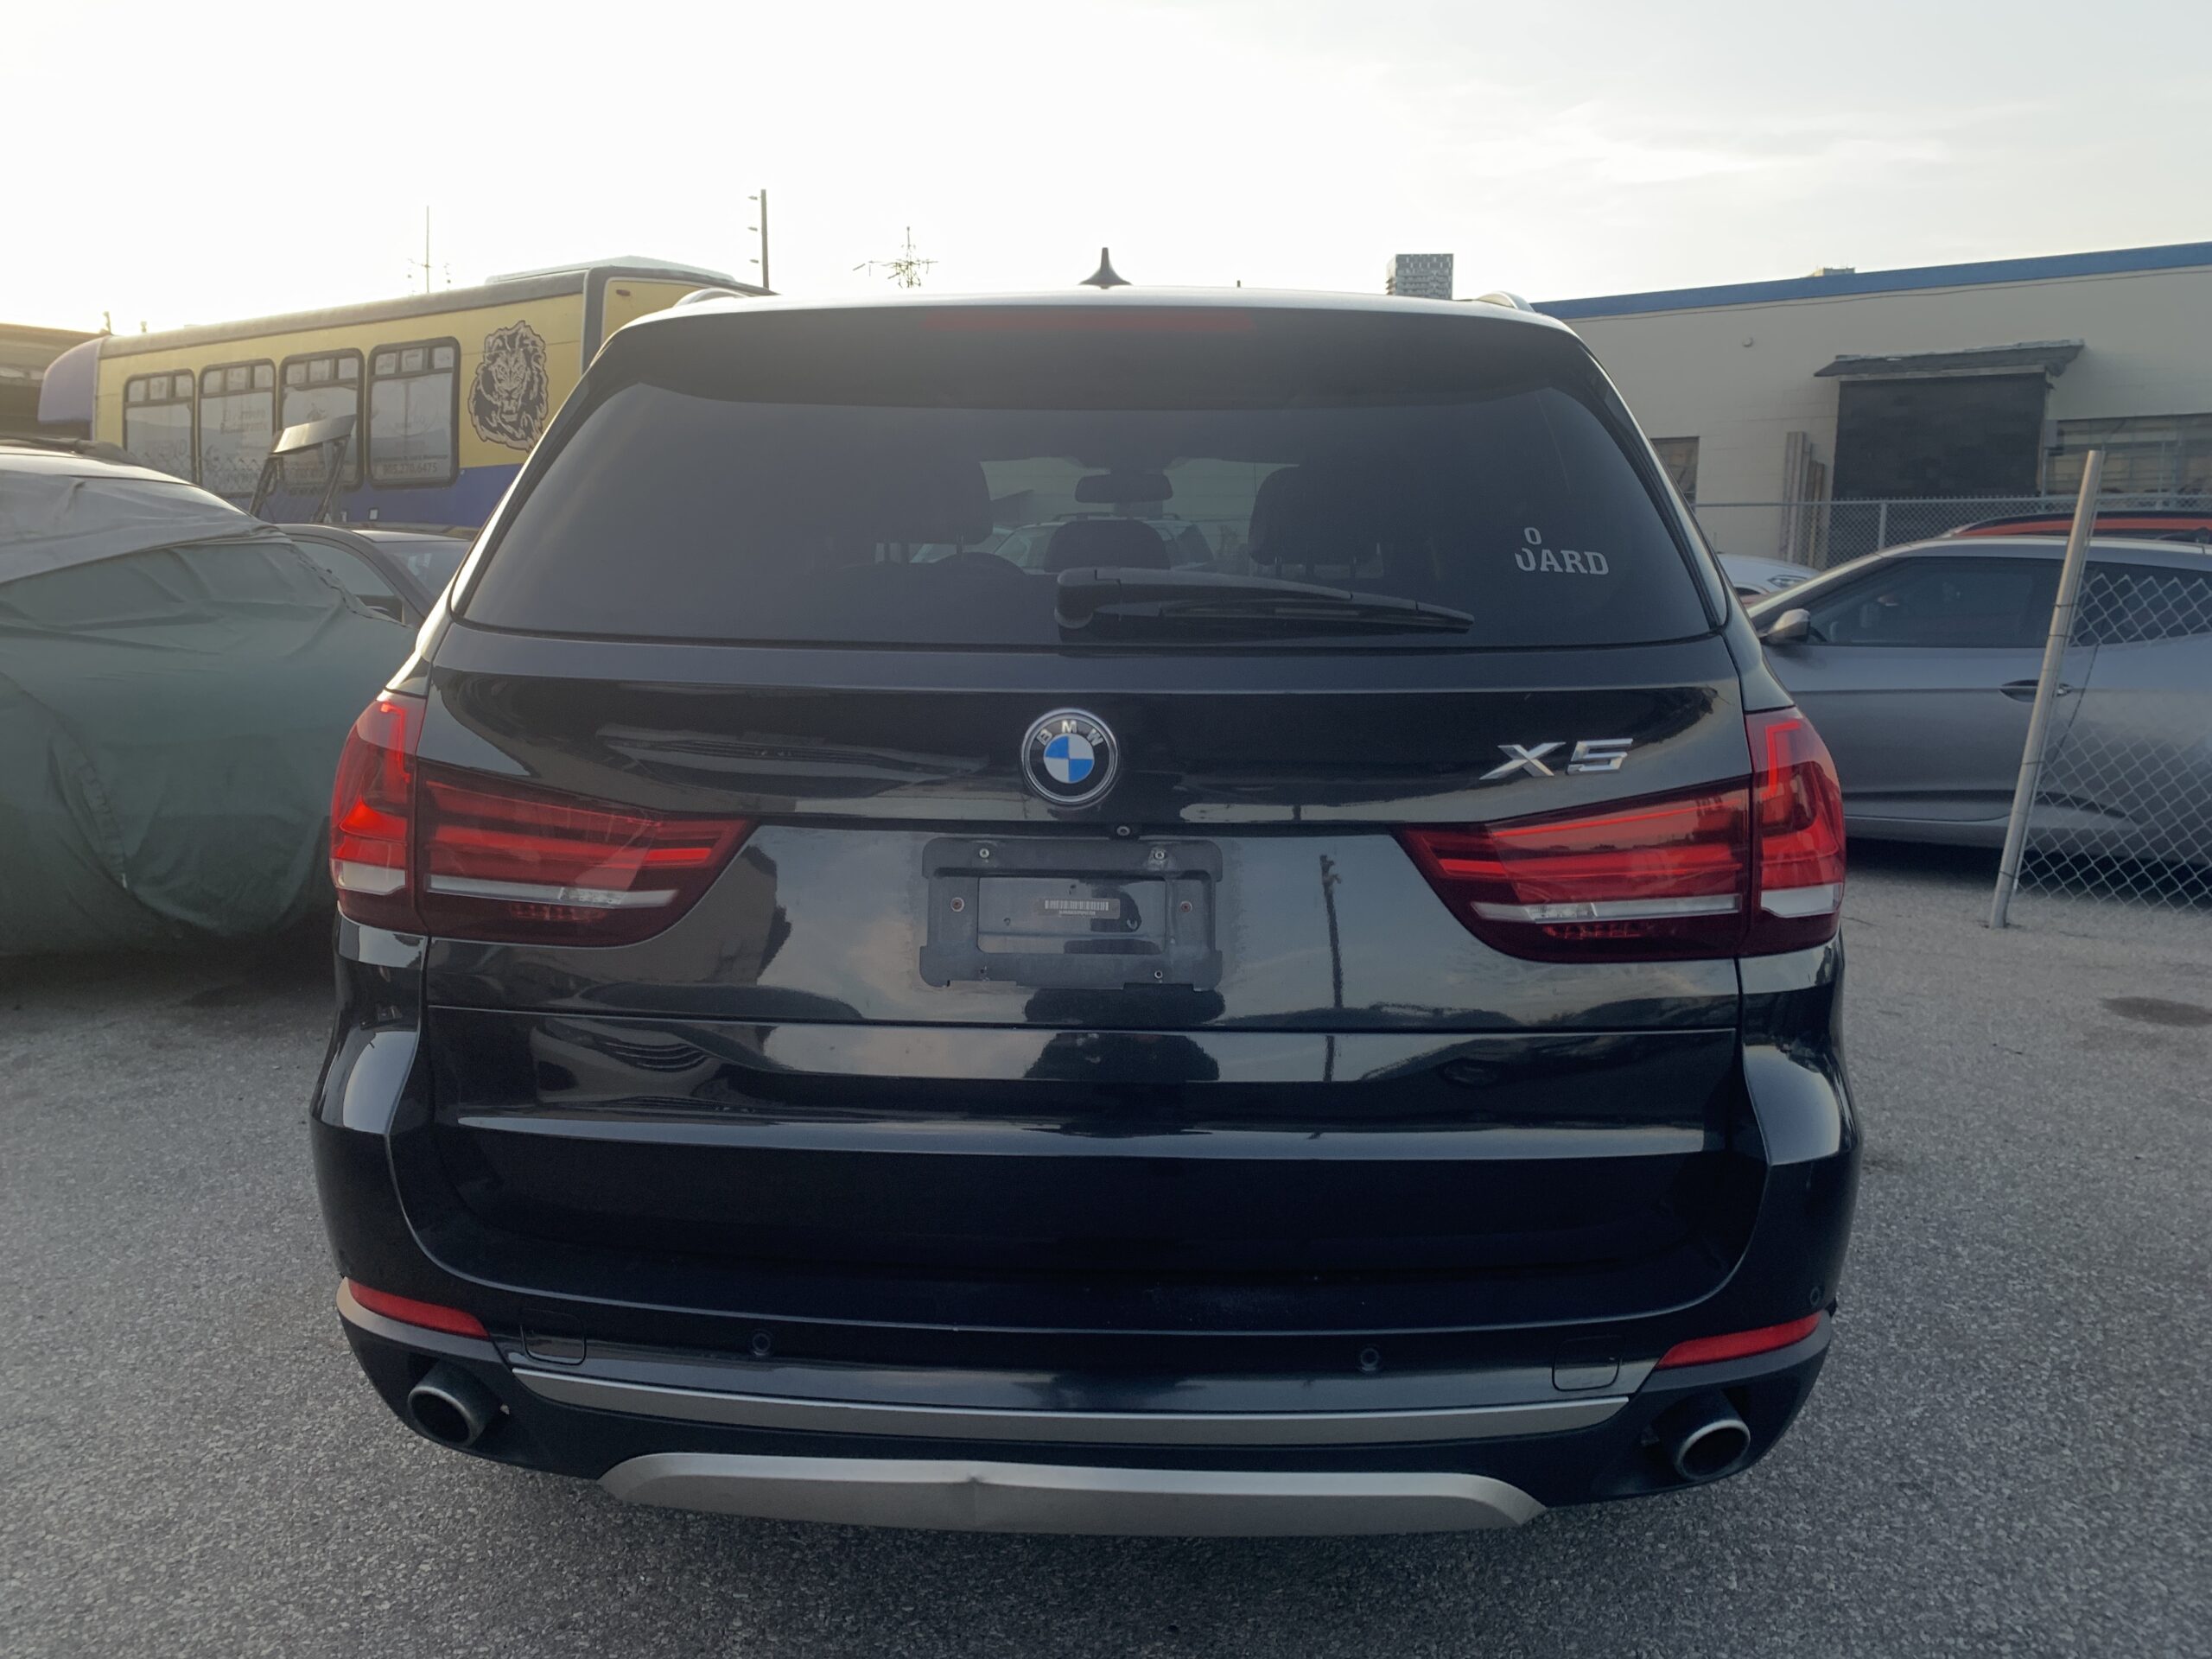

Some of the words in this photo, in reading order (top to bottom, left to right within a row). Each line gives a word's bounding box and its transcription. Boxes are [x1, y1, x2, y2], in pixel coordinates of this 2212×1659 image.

[1524, 527, 1542, 545] O
[1037, 720, 1103, 747] BMW
[1479, 738, 1634, 780] X5
